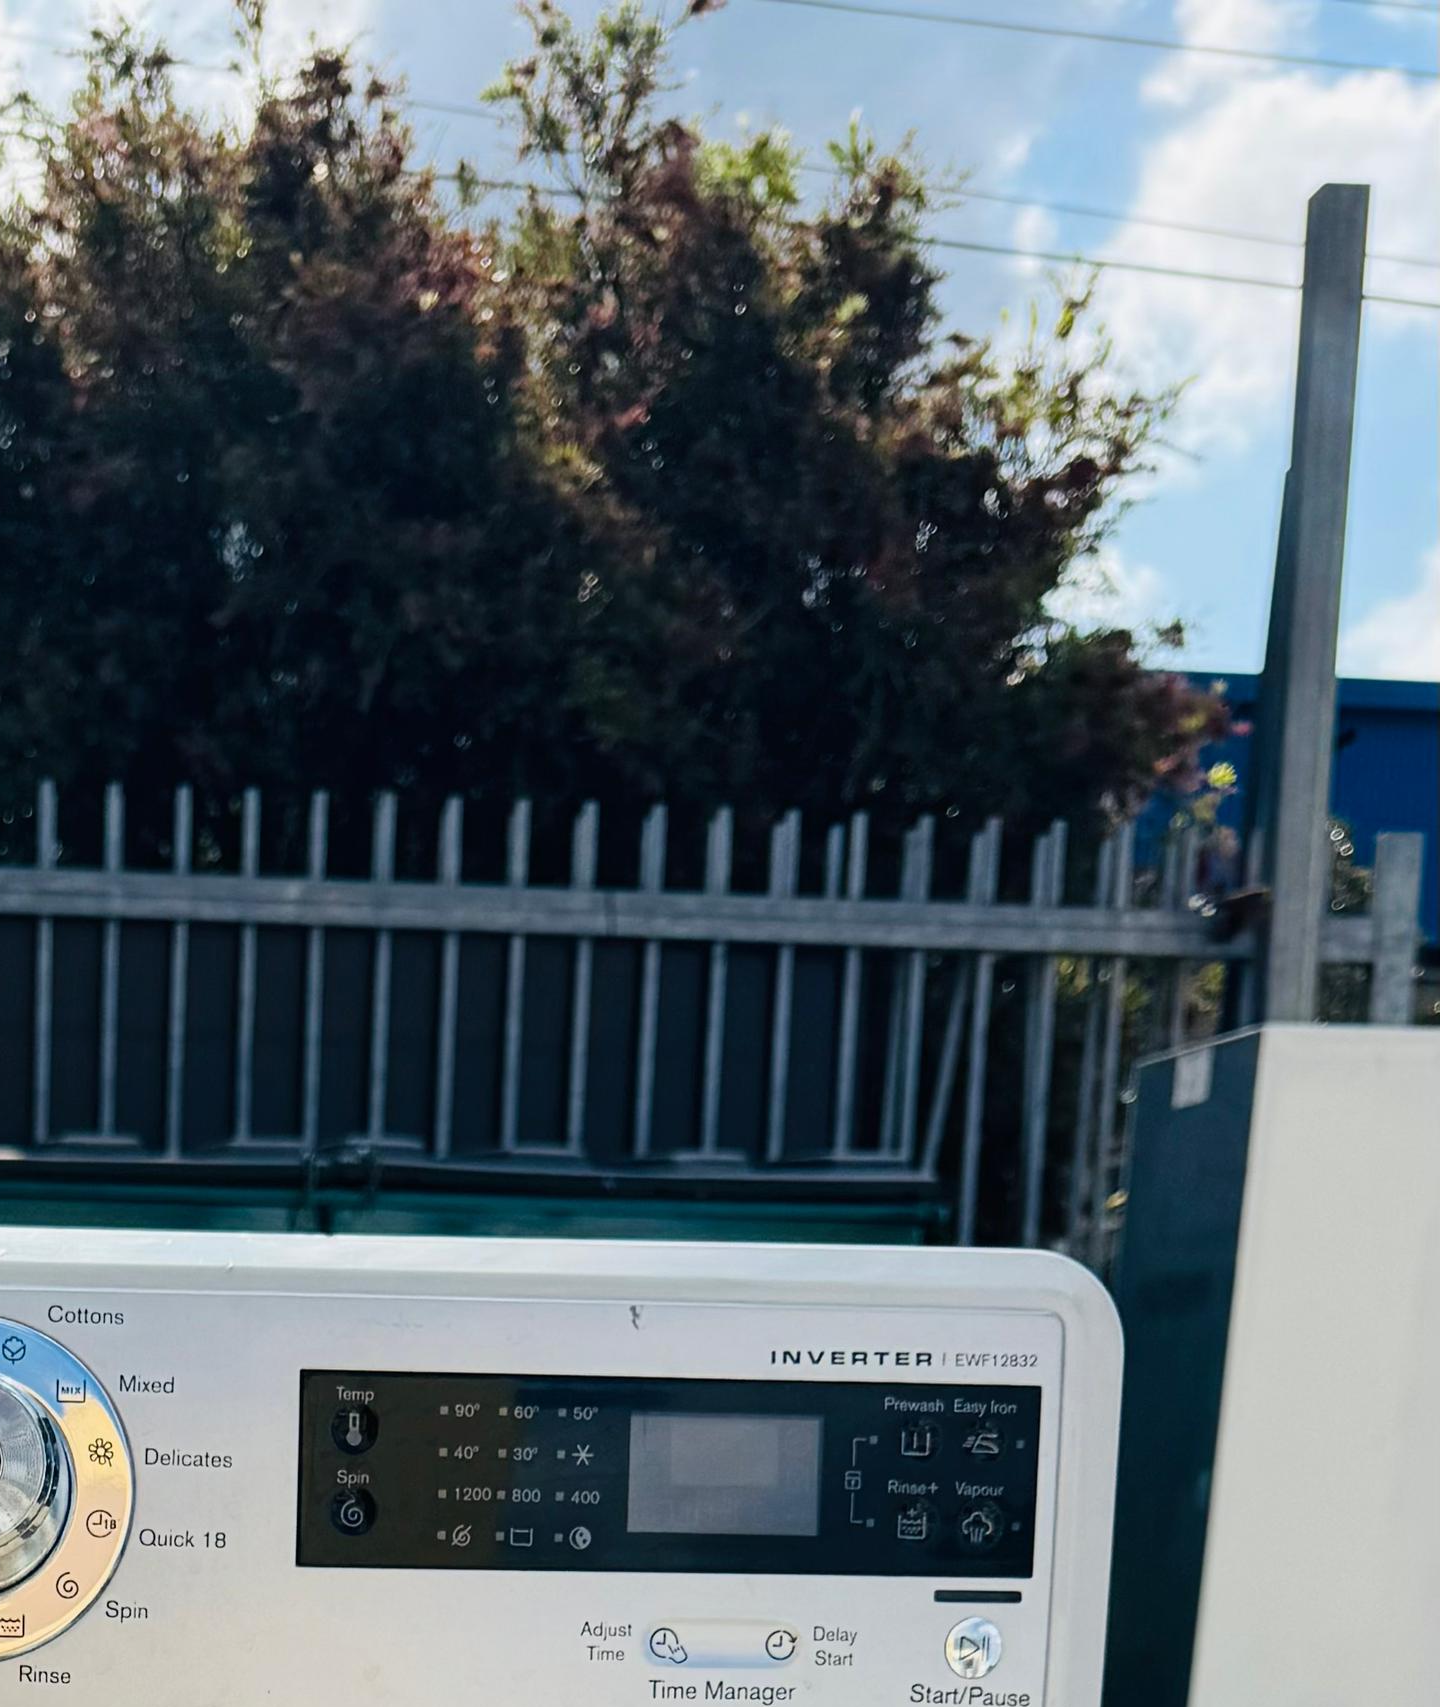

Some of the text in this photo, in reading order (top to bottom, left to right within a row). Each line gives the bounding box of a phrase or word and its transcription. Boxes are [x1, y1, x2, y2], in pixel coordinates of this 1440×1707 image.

[47, 1305, 124, 1325] Cottons
[771, 1351, 1038, 1368] INVERTER EWF12832
[61, 1386, 81, 1395] MIX
[119, 1375, 175, 1394] Mixed
[336, 1385, 375, 1404] Temp
[884, 1397, 944, 1413] Prewash
[954, 1399, 1017, 1417] Easy Iron
[144, 1448, 233, 1469] Delicates
[336, 1470, 370, 1488] Spin
[888, 1480, 939, 1495] Rinse+
[455, 1487, 492, 1501] 1200
[511, 1488, 541, 1503] 800
[571, 1490, 600, 1504] 400
[955, 1482, 1004, 1499] Vapour
[138, 1529, 227, 1550] Quick 18
[105, 1600, 148, 1622] Spin
[580, 1622, 632, 1640] Adjust
[813, 1626, 858, 1645] Delay
[586, 1646, 624, 1662] Time
[815, 1651, 853, 1667] Start
[18, 1665, 71, 1685] Rinse
[649, 1680, 796, 1705] Time Manager
[910, 1683, 1030, 1707] Start/Pause
